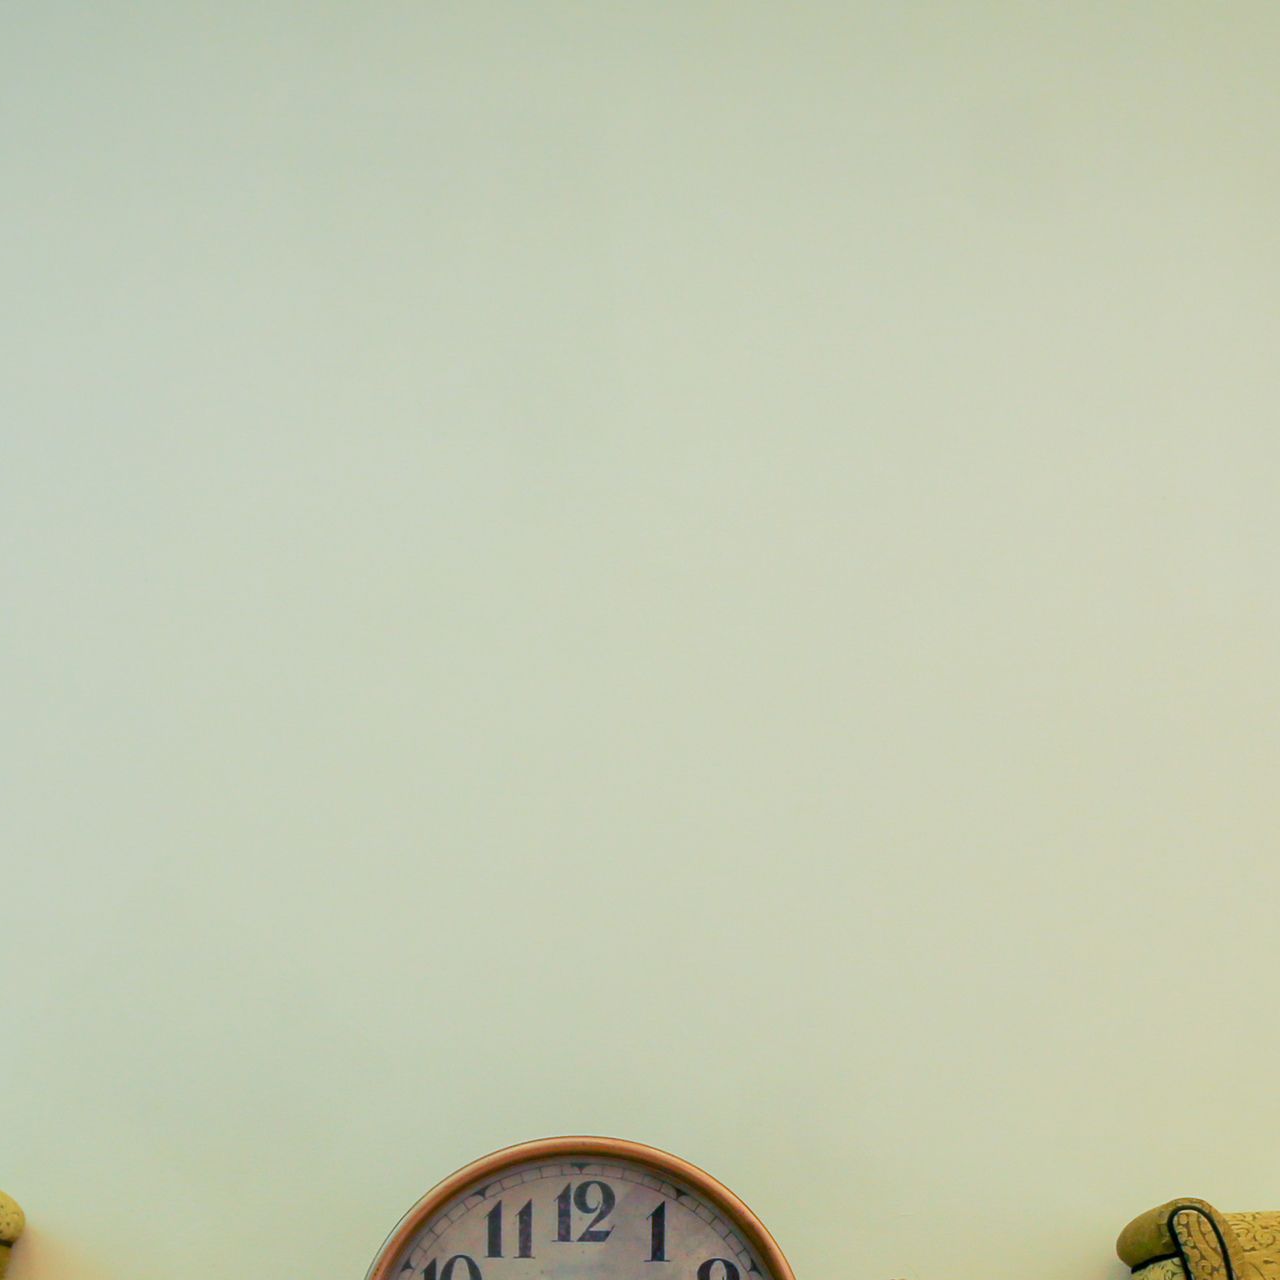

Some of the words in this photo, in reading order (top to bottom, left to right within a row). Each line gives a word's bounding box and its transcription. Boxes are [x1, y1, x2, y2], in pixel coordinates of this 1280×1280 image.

[484, 1199, 534, 1259] 11
[552, 1181, 615, 1243] 12
[644, 1201, 671, 1262] 1
